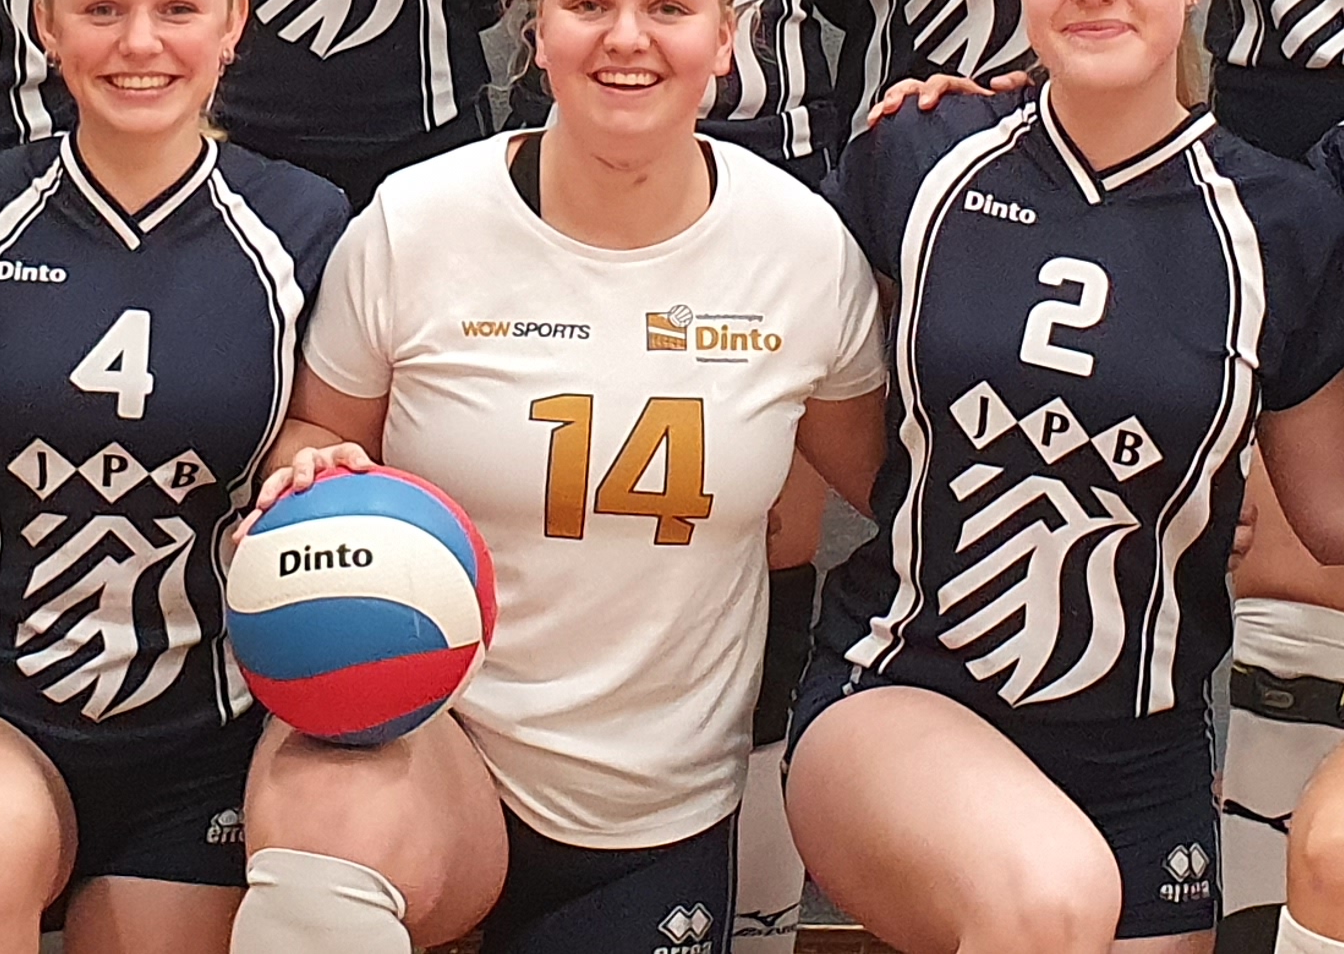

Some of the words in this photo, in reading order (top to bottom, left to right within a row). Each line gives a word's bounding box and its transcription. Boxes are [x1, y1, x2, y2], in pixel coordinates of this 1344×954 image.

[964, 190, 1036, 224] Dinto
[461, 321, 511, 337] WOW
[512, 322, 591, 339] SPORTS
[1019, 256, 1109, 377] 2
[695, 324, 782, 352] Dinto
[69, 309, 154, 419] 4
[529, 392, 714, 546] 14
[279, 543, 373, 578] Dinto
